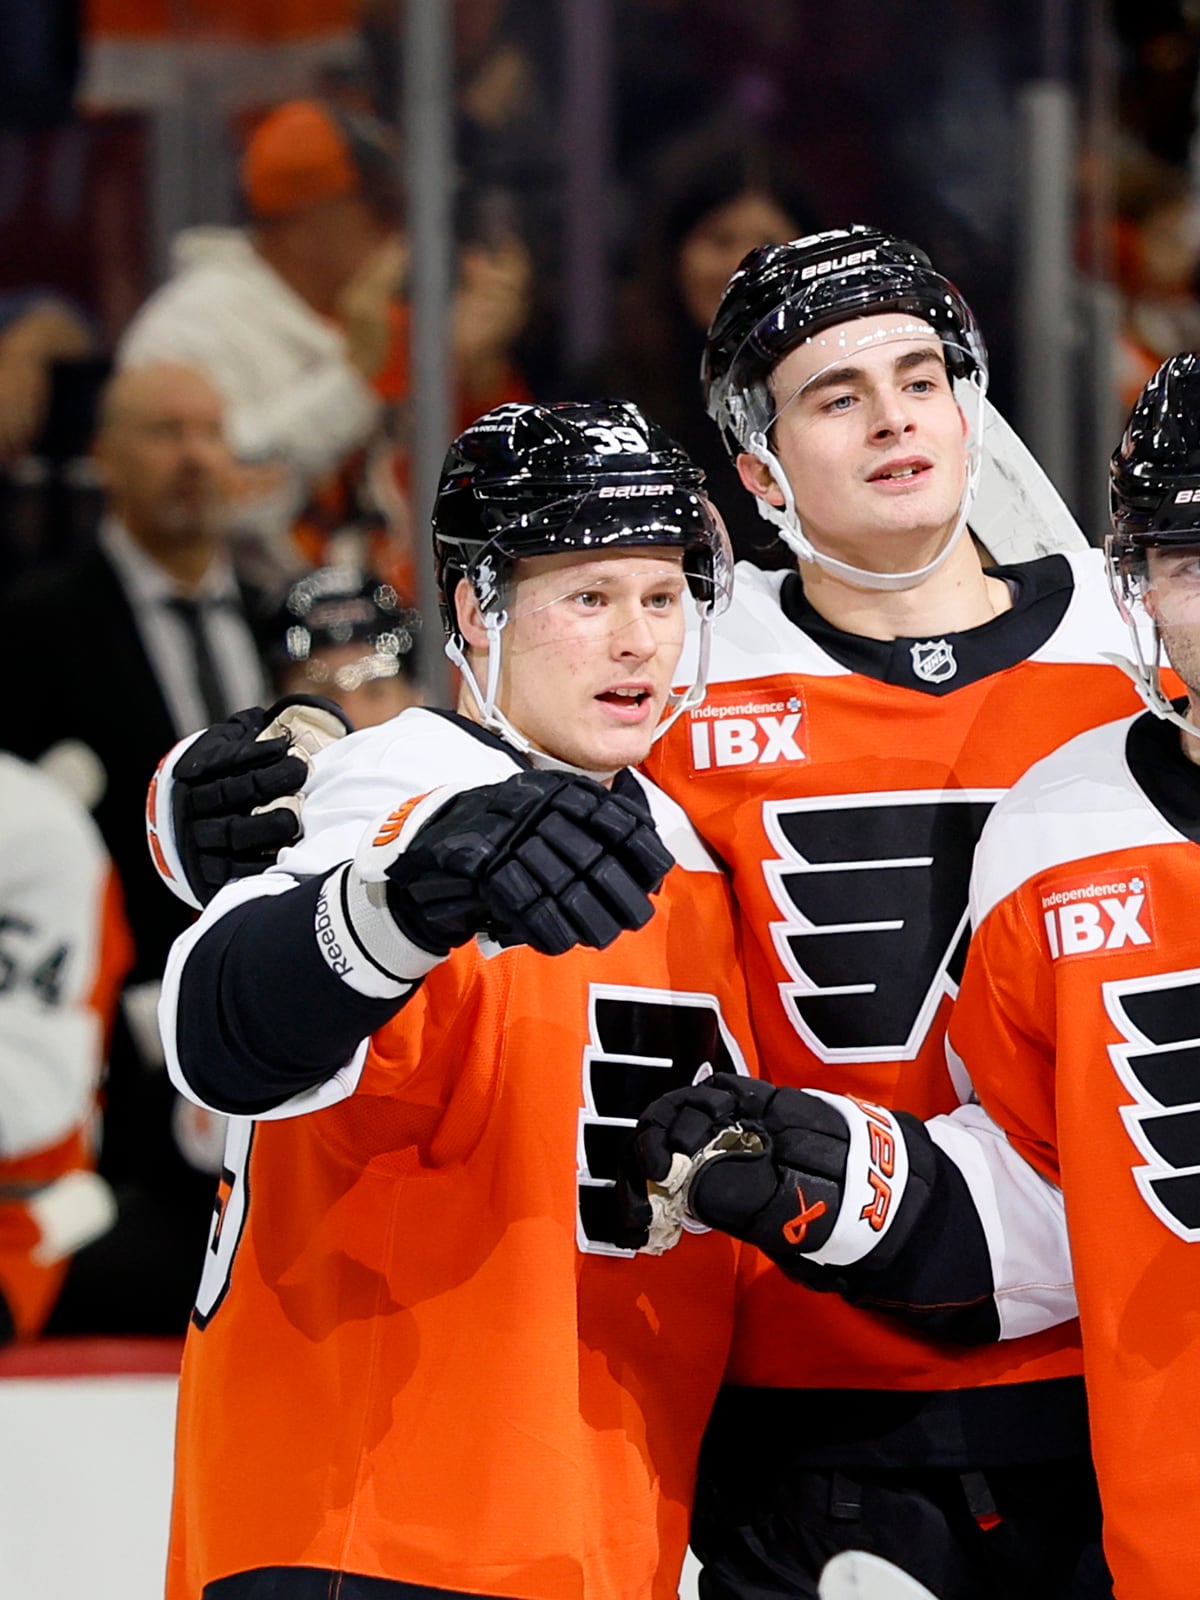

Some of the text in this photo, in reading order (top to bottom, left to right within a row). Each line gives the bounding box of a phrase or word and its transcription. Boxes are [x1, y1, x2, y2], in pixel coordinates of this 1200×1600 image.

[801, 249, 877, 281] BAUER
[584, 426, 649, 455] 39
[599, 484, 674, 498] BAUER
[690, 700, 785, 719] Independence
[690, 713, 806, 771] IBX
[1042, 882, 1127, 909] Independence
[1043, 894, 1152, 961] IBX
